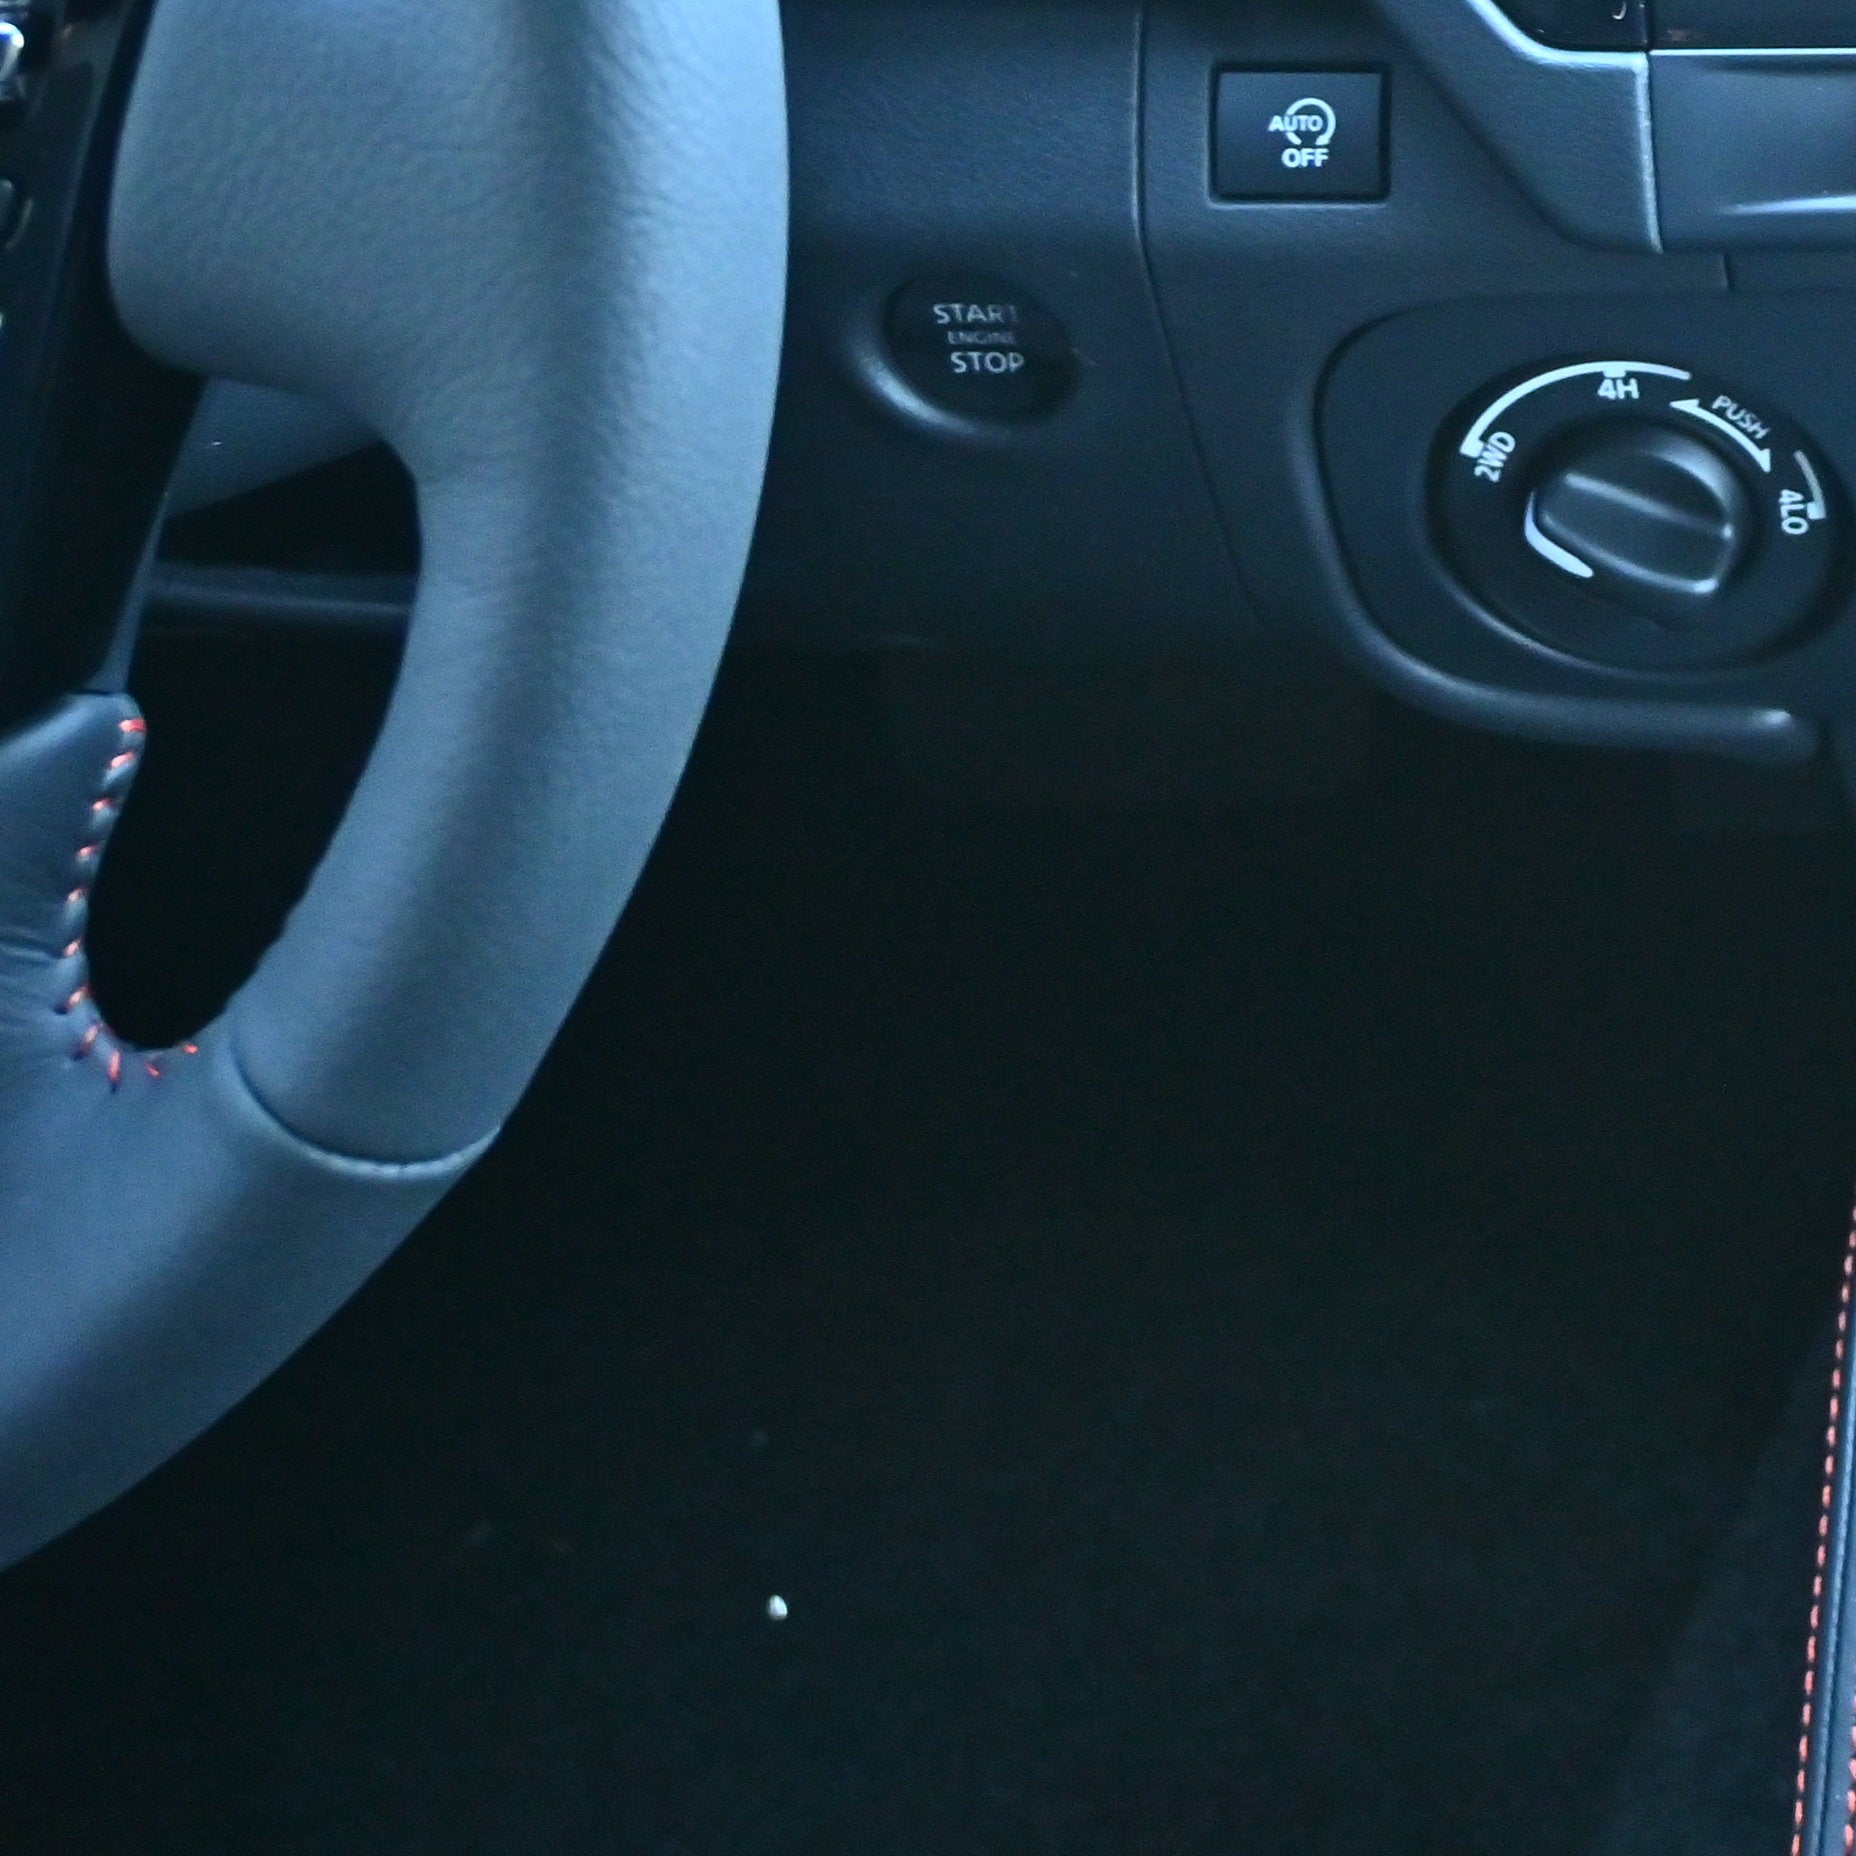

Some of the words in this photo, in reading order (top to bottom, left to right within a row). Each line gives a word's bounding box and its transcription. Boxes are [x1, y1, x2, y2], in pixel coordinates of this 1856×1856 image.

[1268, 115, 1324, 132] AUTO
[1281, 147, 1329, 168] OFF
[950, 351, 1025, 373] STOP
[1597, 378, 1639, 400] 4H
[1711, 394, 1770, 440] PUSH
[1474, 431, 1516, 482] 2WD
[1778, 488, 1809, 535] 4LO
